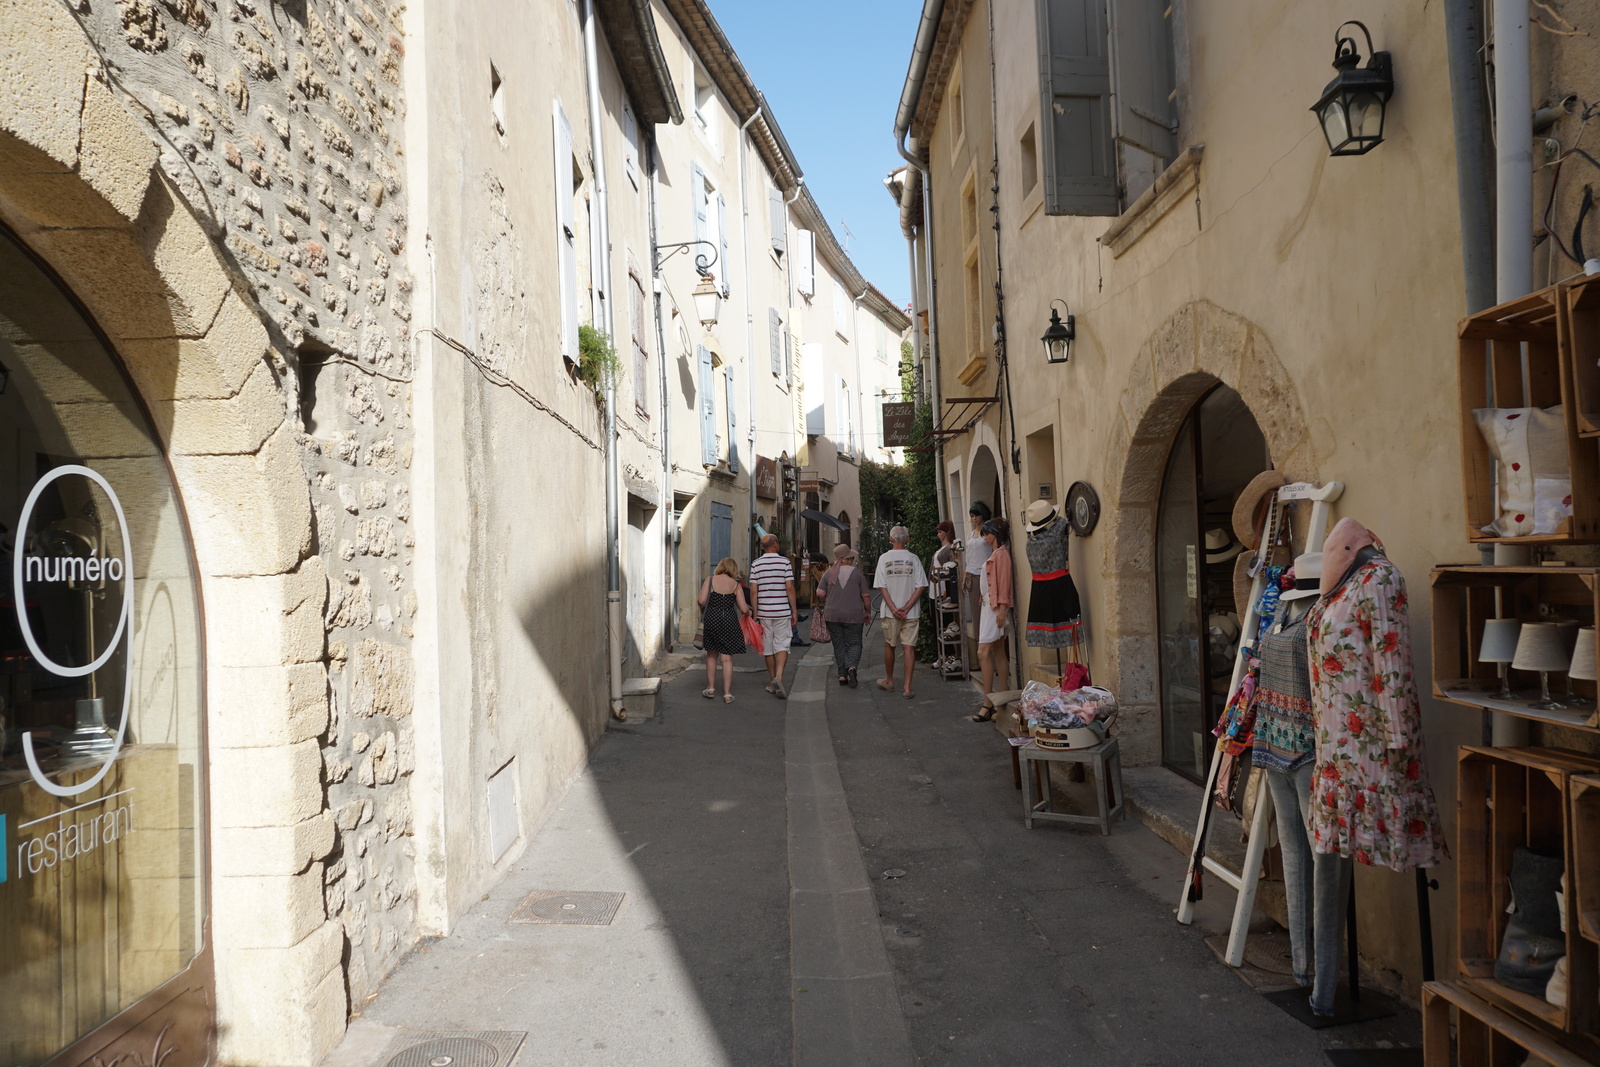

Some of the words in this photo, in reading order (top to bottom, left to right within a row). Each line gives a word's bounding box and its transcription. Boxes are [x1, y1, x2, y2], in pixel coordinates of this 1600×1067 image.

[893, 419, 905, 429] des
[26, 549, 123, 582] numéro
[18, 796, 136, 879] restaurant
